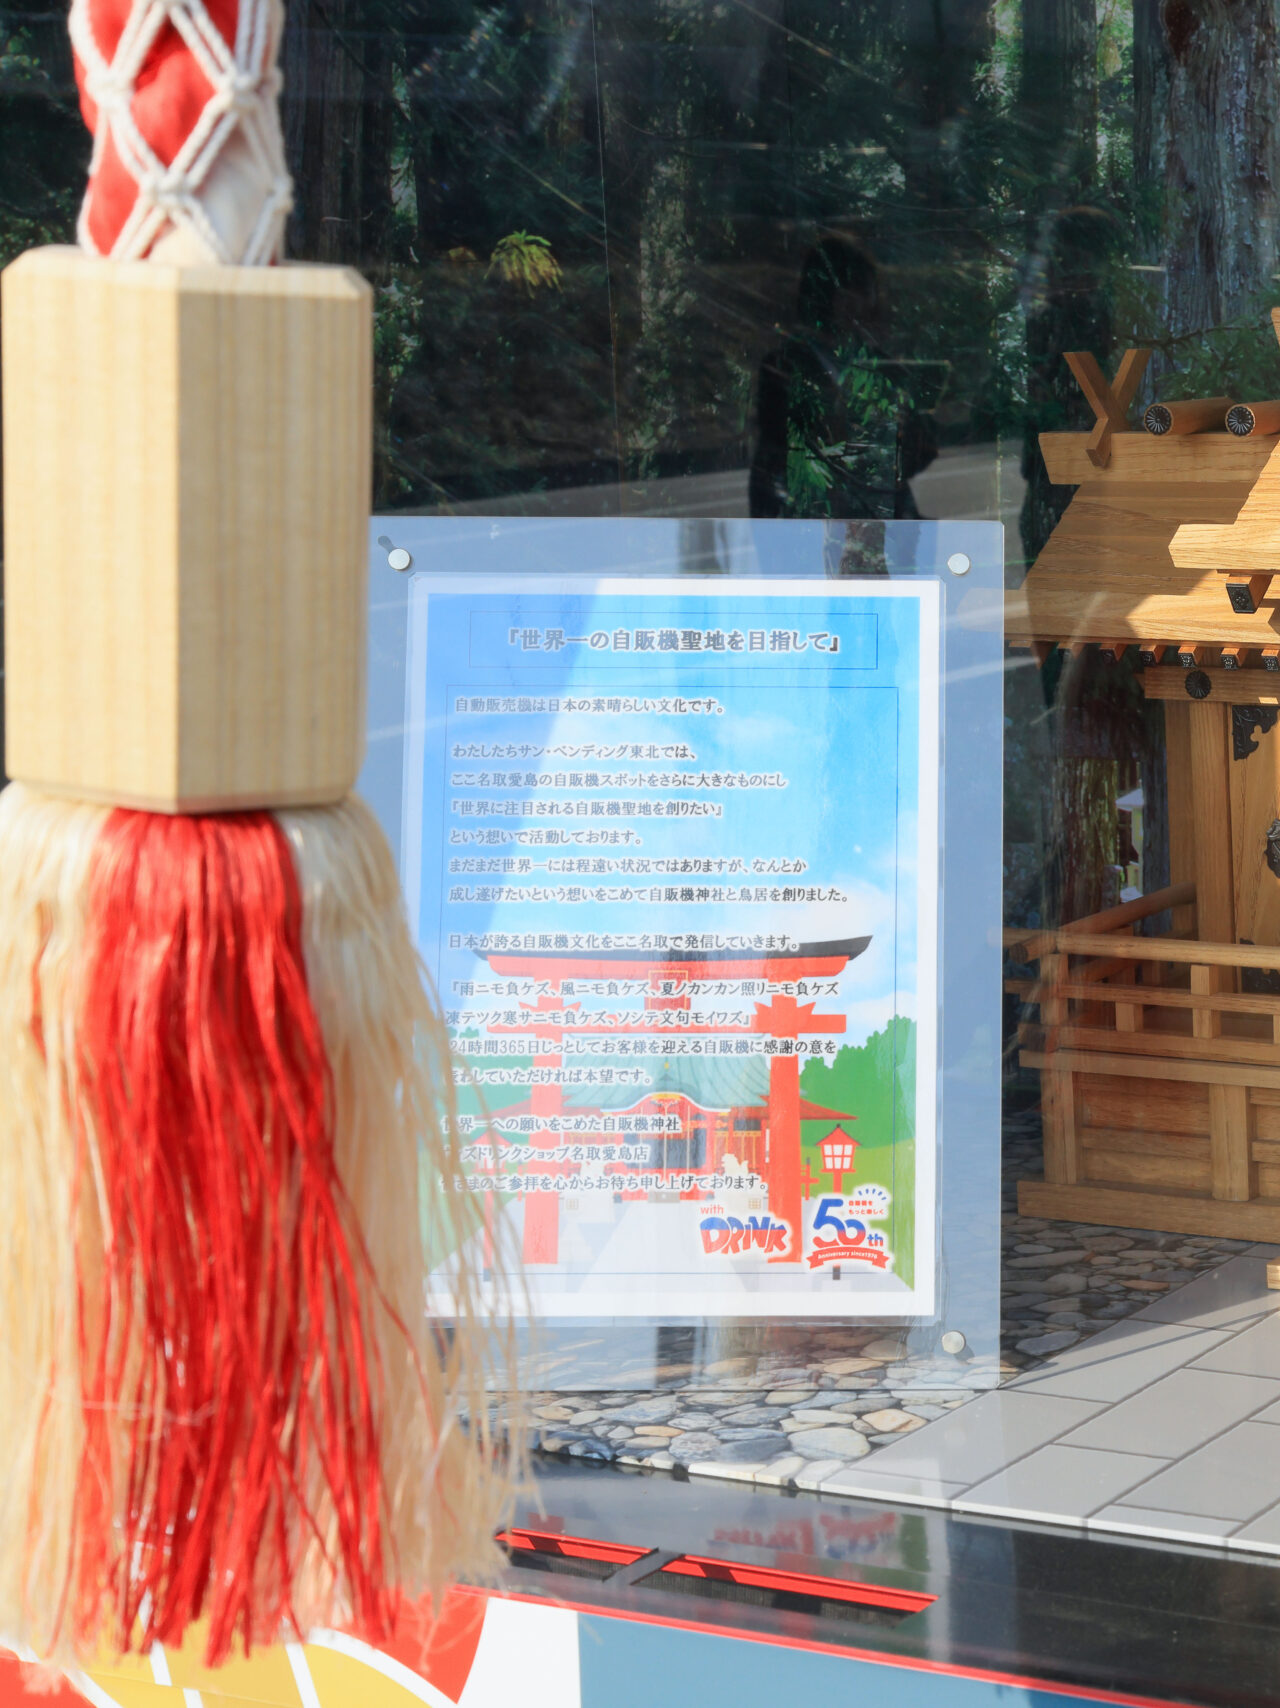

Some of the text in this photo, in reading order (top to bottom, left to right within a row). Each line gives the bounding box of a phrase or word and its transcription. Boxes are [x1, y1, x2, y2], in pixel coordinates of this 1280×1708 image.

[508, 628, 840, 653] 『世界一の自販機聖地を目指して』
[455, 697, 724, 714] 自動販売機は日本の素晴らしい文化です。
[453, 744, 697, 760] わたしたちサン・ベンディング東北では、
[452, 772, 787, 788] ここ名取愛島の自販機スポットをさらに大きなものにし
[450, 829, 642, 845] という想いで活動しております。
[449, 858, 807, 874] まだまだ世界一には程遠い状況ではありますが、なんとか
[449, 886, 848, 903] 成し遂げたいという想いをこめて自販機神社と鳥居を創りました。
[449, 934, 799, 950] 日本が誇る自販機文化をここ名取で発信していきます。
[450, 1039, 836, 1055] 24時間365日じっとしてお客様を迎える自販機に感謝の意を
[444, 1145, 649, 1161] ズドリンクショップ名取愛島店
[442, 1174, 767, 1191] さまのご参拝を心からお待ち申し上げております。
[700, 1204, 724, 1215] with
[699, 1216, 788, 1254] DRINK
